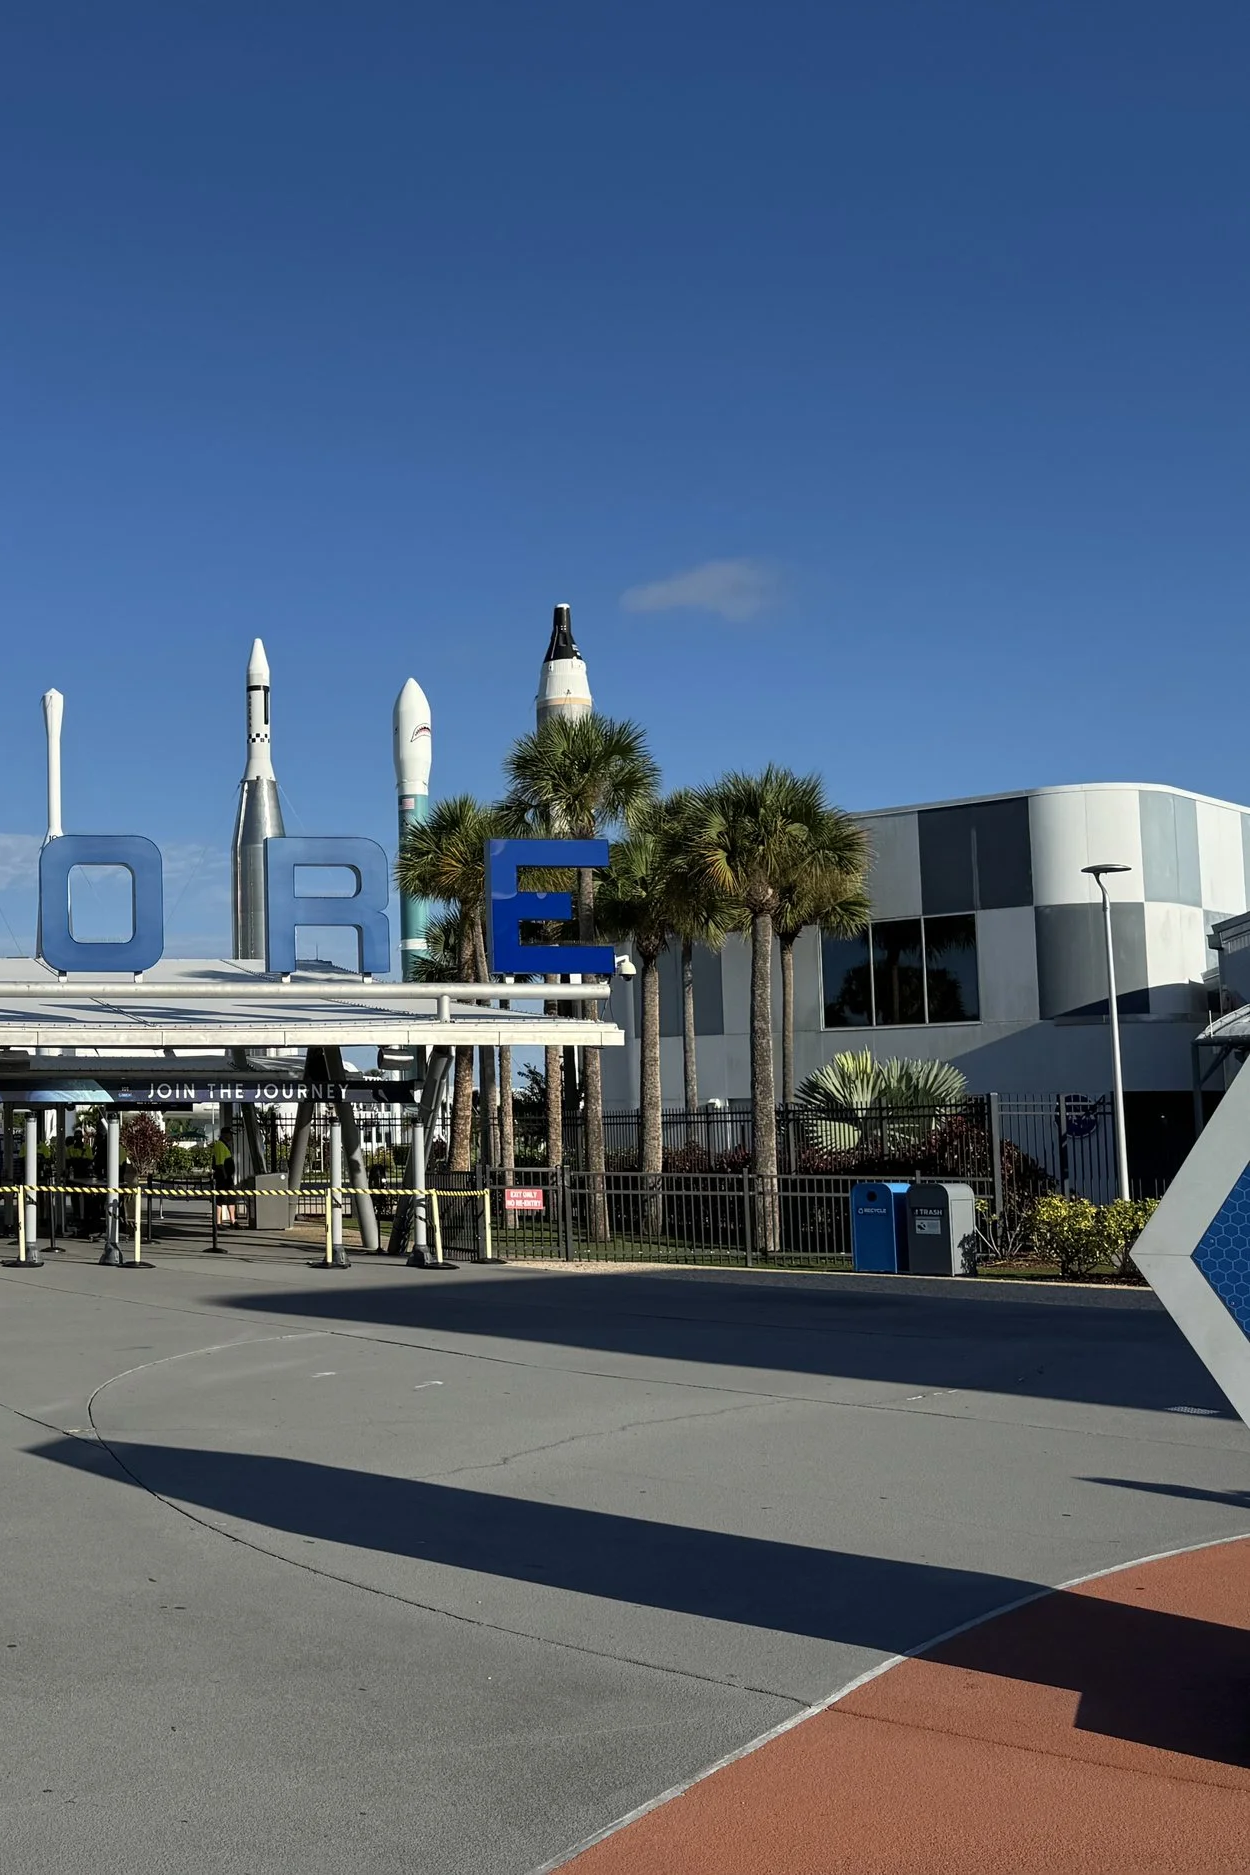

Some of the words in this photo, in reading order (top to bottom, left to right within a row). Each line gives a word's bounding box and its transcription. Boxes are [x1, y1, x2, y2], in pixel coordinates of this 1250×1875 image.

[147, 1083, 195, 1099] JOIN
[207, 1083, 244, 1099] THE
[254, 1083, 350, 1099] JOURNEY
[507, 1199, 515, 1207] NO
[918, 1208, 943, 1216] TRASH
